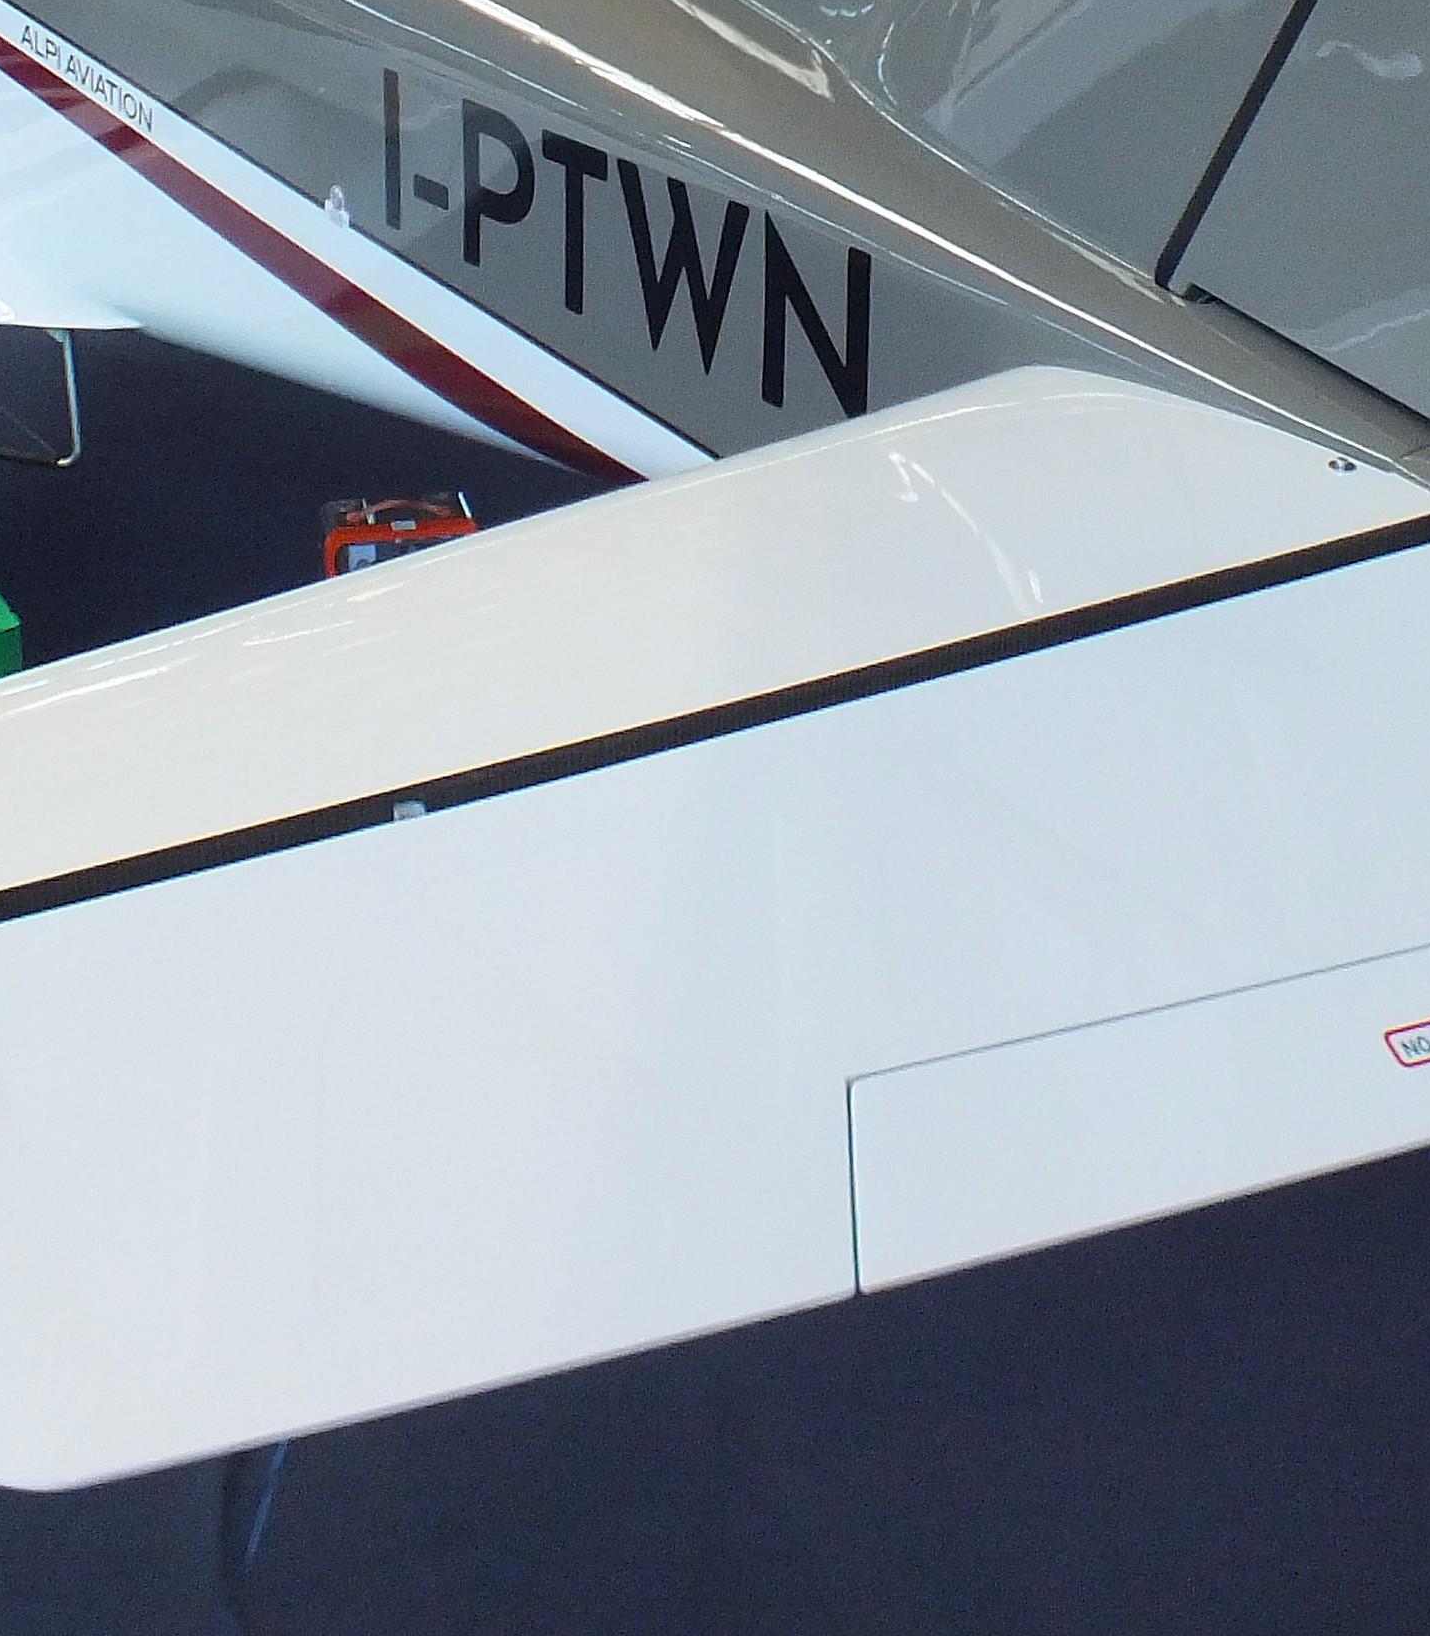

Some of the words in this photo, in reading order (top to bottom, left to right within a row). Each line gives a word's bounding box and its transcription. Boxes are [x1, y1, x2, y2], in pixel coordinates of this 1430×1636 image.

[21, 25, 62, 70] ALPI
[65, 55, 153, 132] AVIATION
[383, 68, 872, 419] I-PTWN
